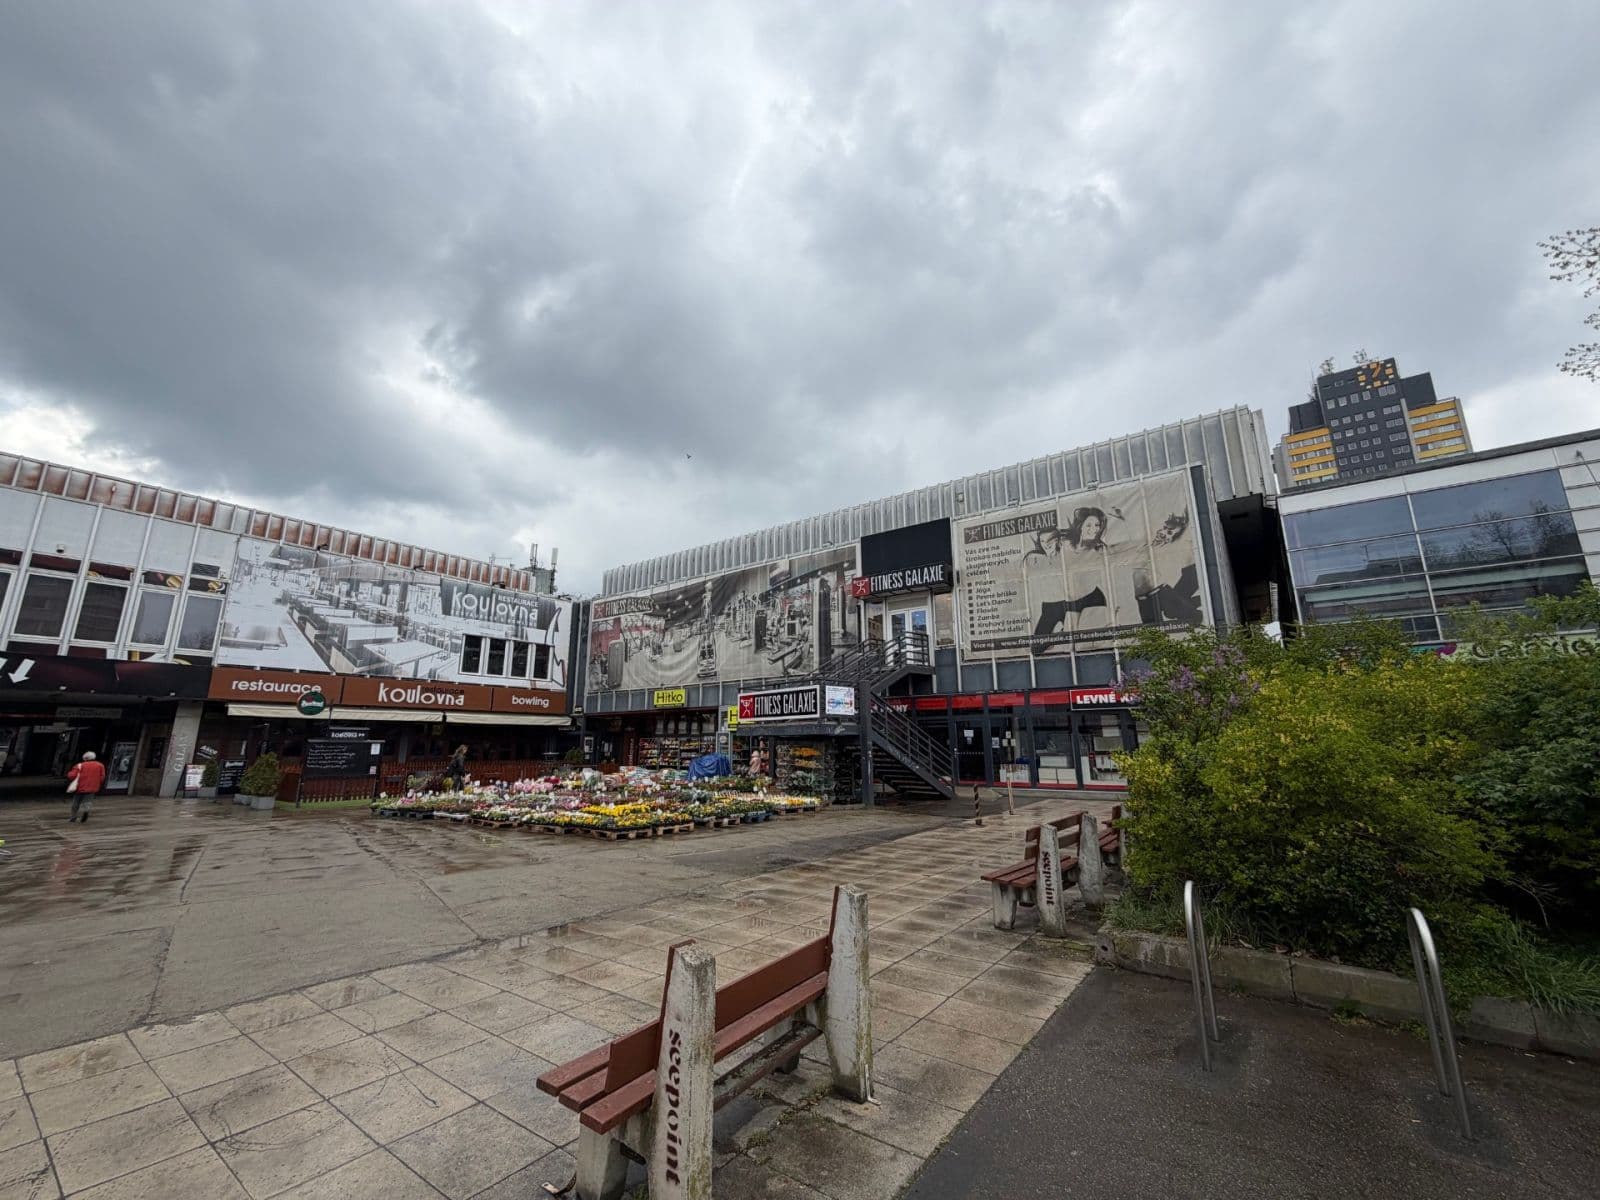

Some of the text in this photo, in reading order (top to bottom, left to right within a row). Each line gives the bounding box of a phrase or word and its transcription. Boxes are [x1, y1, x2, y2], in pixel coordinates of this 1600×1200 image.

[983, 511, 1057, 540] FITNESS GALAXIE
[870, 564, 945, 592] FITNESS GALAXIE
[451, 586, 538, 622] koulovna
[231, 679, 550, 709] restaurace koulovna bowling
[656, 691, 683, 704] Hitko
[754, 694, 782, 716] FITNESS
[783, 691, 816, 714] GALAXIE
[1076, 691, 1117, 705] LEVNÉ
[665, 1028, 682, 1186] seepoint
